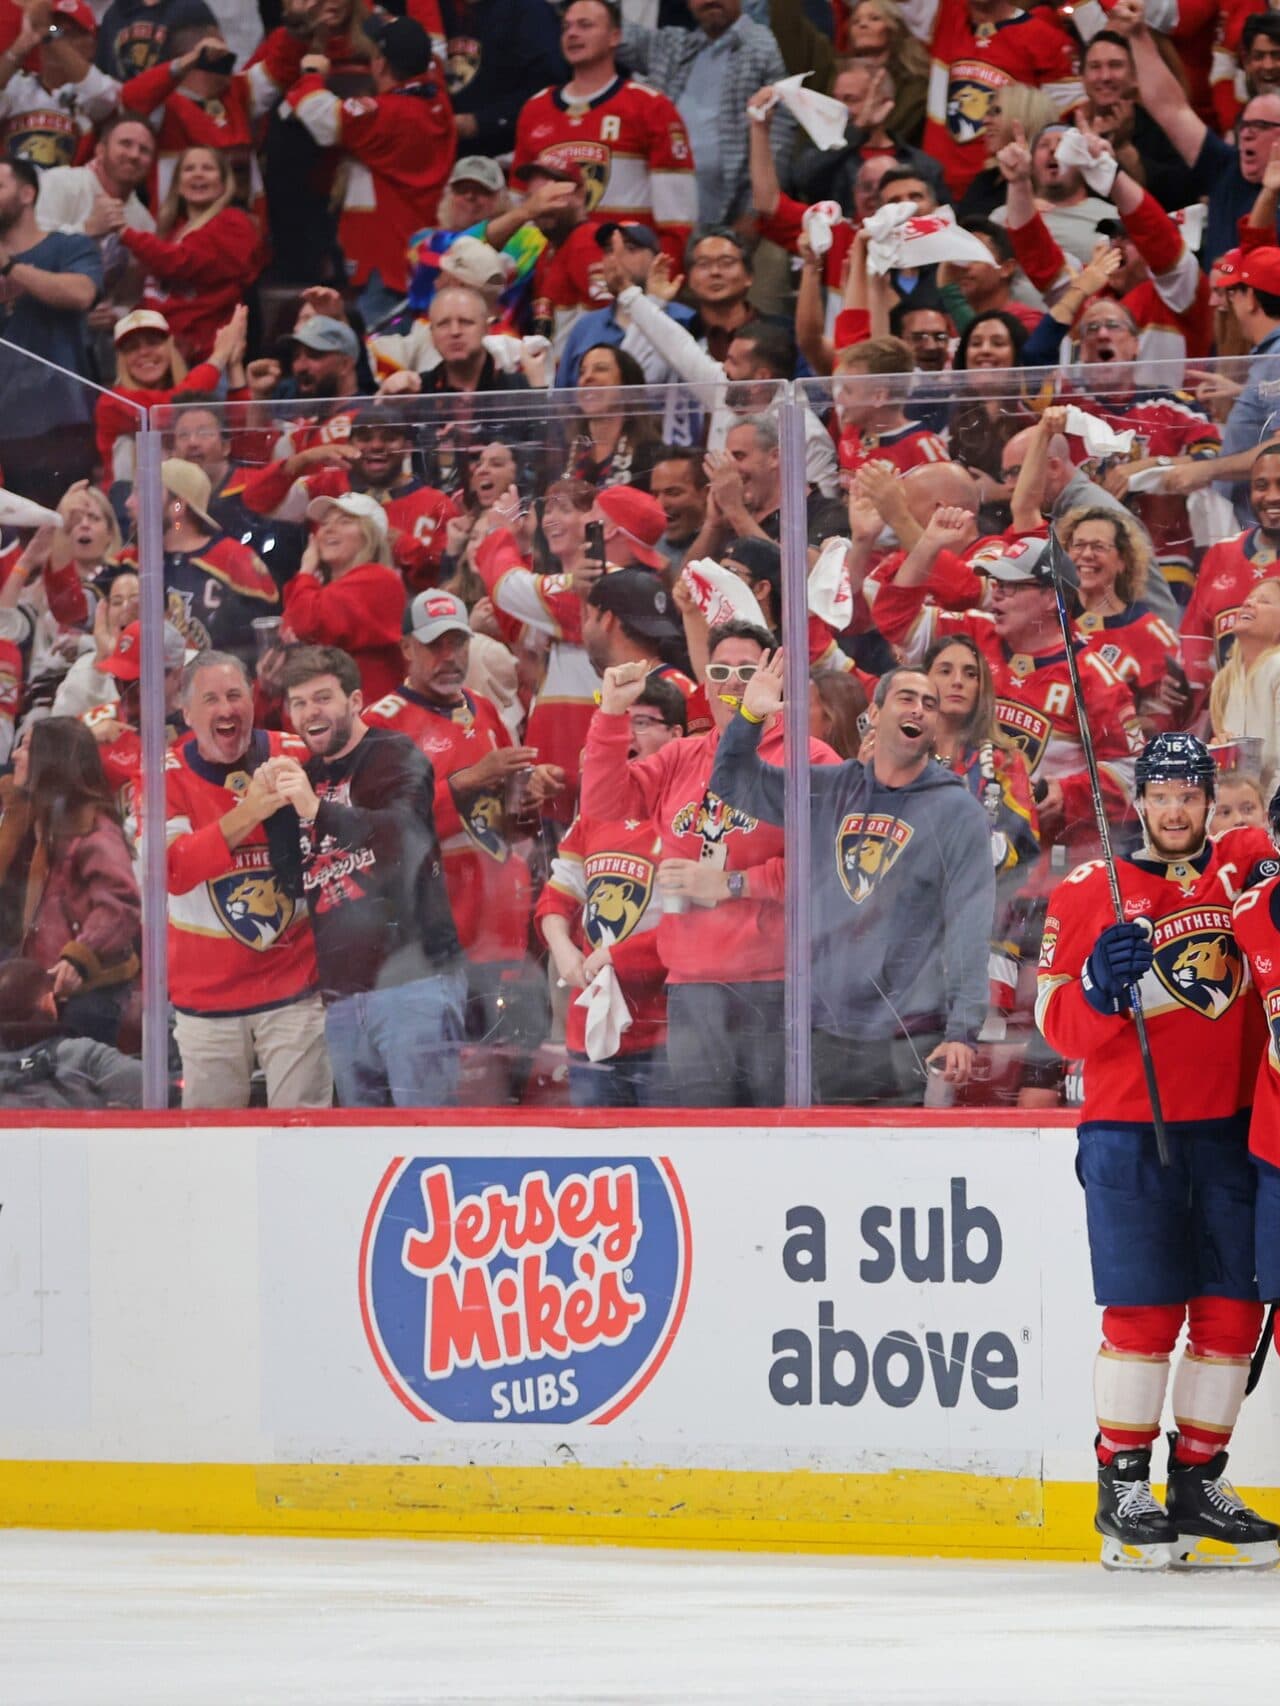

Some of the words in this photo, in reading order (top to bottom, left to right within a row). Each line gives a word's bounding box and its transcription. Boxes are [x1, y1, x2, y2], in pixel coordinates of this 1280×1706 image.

[602, 115, 620, 141] A
[1043, 681, 1070, 716] A
[995, 704, 1043, 735] THERS
[1166, 740, 1187, 753] 16
[585, 857, 645, 879] PANTHERS
[1218, 863, 1241, 901] C
[1153, 912, 1232, 945] PANTHERS
[404, 1166, 641, 1272] Jersey
[782, 1205, 826, 1283] a
[859, 1177, 1003, 1285] sub
[426, 1253, 644, 1377] Mike's
[768, 1300, 1019, 1411] above
[491, 1368, 580, 1419] SUBS
